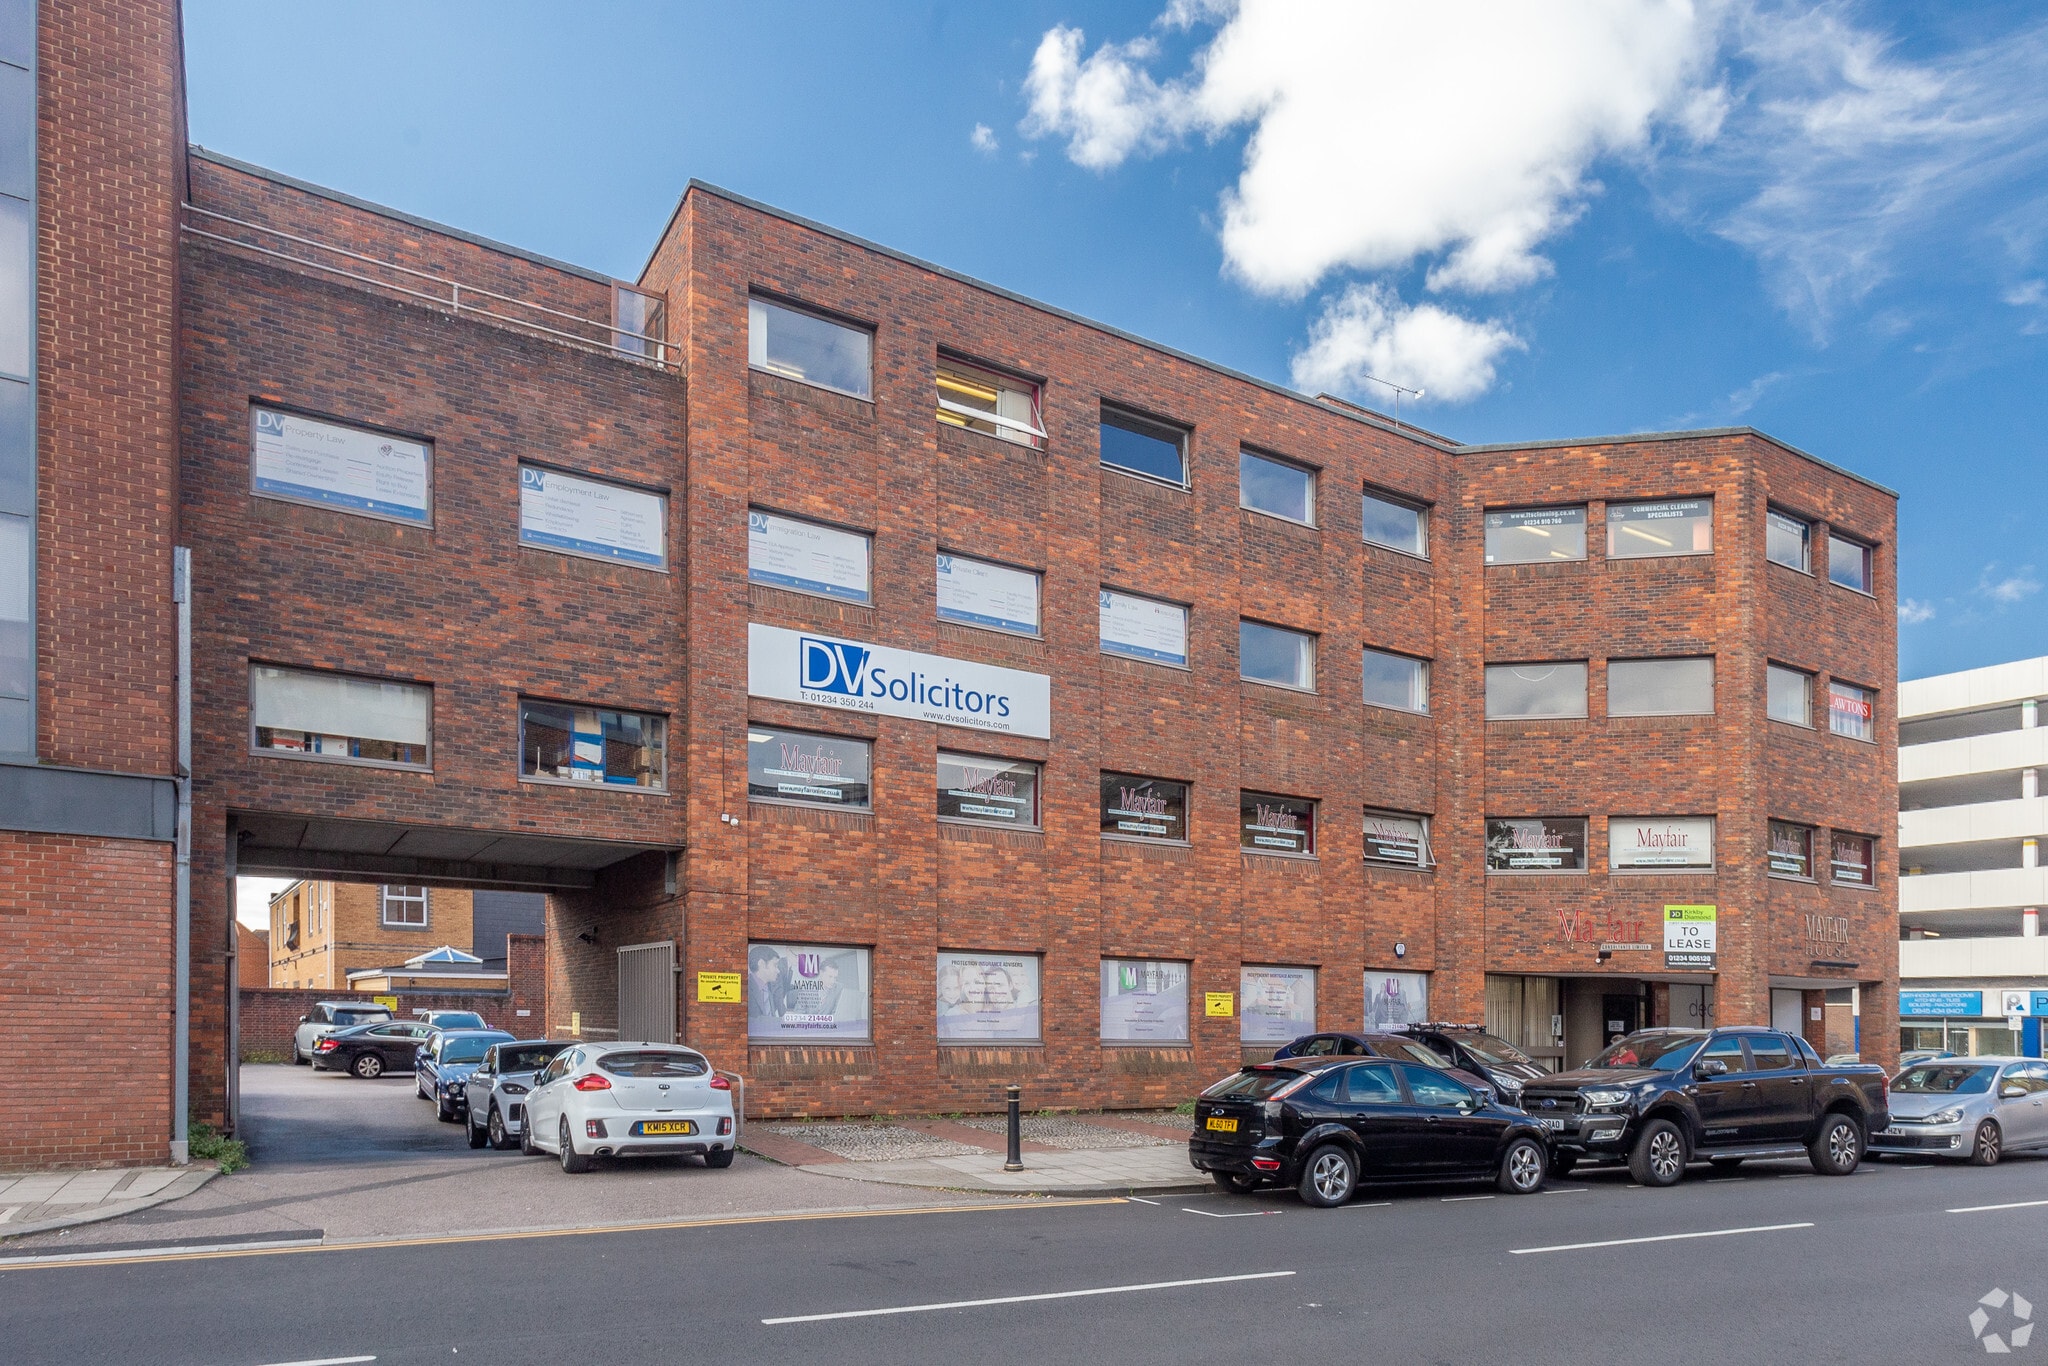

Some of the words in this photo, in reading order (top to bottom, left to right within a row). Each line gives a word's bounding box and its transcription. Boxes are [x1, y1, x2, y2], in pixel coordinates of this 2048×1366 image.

[257, 411, 284, 431] DV
[285, 424, 324, 441] Property
[326, 434, 346, 445] Law
[522, 468, 544, 487] DV
[545, 480, 593, 498] Employment
[594, 490, 610, 501] Law
[1632, 503, 1669, 513] COMMERCIAL
[1670, 502, 1699, 511] CLEANING
[1647, 510, 1684, 519] SPECIALISTS
[749, 512, 768, 529] DV
[768, 523, 806, 537] Immigration
[807, 531, 821, 541] Law
[936, 555, 952, 571] DV
[953, 564, 972, 575] Private
[801, 637, 870, 696] DV
[870, 667, 1010, 717] Solicitors
[800, 691, 809, 701] T:
[810, 692, 838, 705] 01234
[840, 696, 856, 708] 350
[858, 699, 874, 710] 244
[922, 710, 1010, 730] www.dvsolicitors.com
[780, 743, 842, 783] Mayfair
[963, 767, 1016, 803] Mayfair
[1120, 786, 1167, 821] Mayfair
[1256, 803, 1297, 836] Mayfair
[1511, 826, 1563, 857] Mayfair
[1637, 825, 1689, 854] Mayfair
[1681, 926, 1699, 936] TO
[1805, 914, 1849, 943] MAYFAIR
[1669, 938, 1711, 949] LEASE
[1805, 941, 1849, 958] HOUSE
[804, 954, 818, 974] M
[1668, 954, 1688, 962] 01234
[1140, 969, 1165, 981] MAYFAIR
[793, 980, 824, 991] MAYFAIR
[2036, 997, 2048, 1009] P
[647, 1122, 667, 1132] KM15
[669, 1122, 686, 1132] XCR
